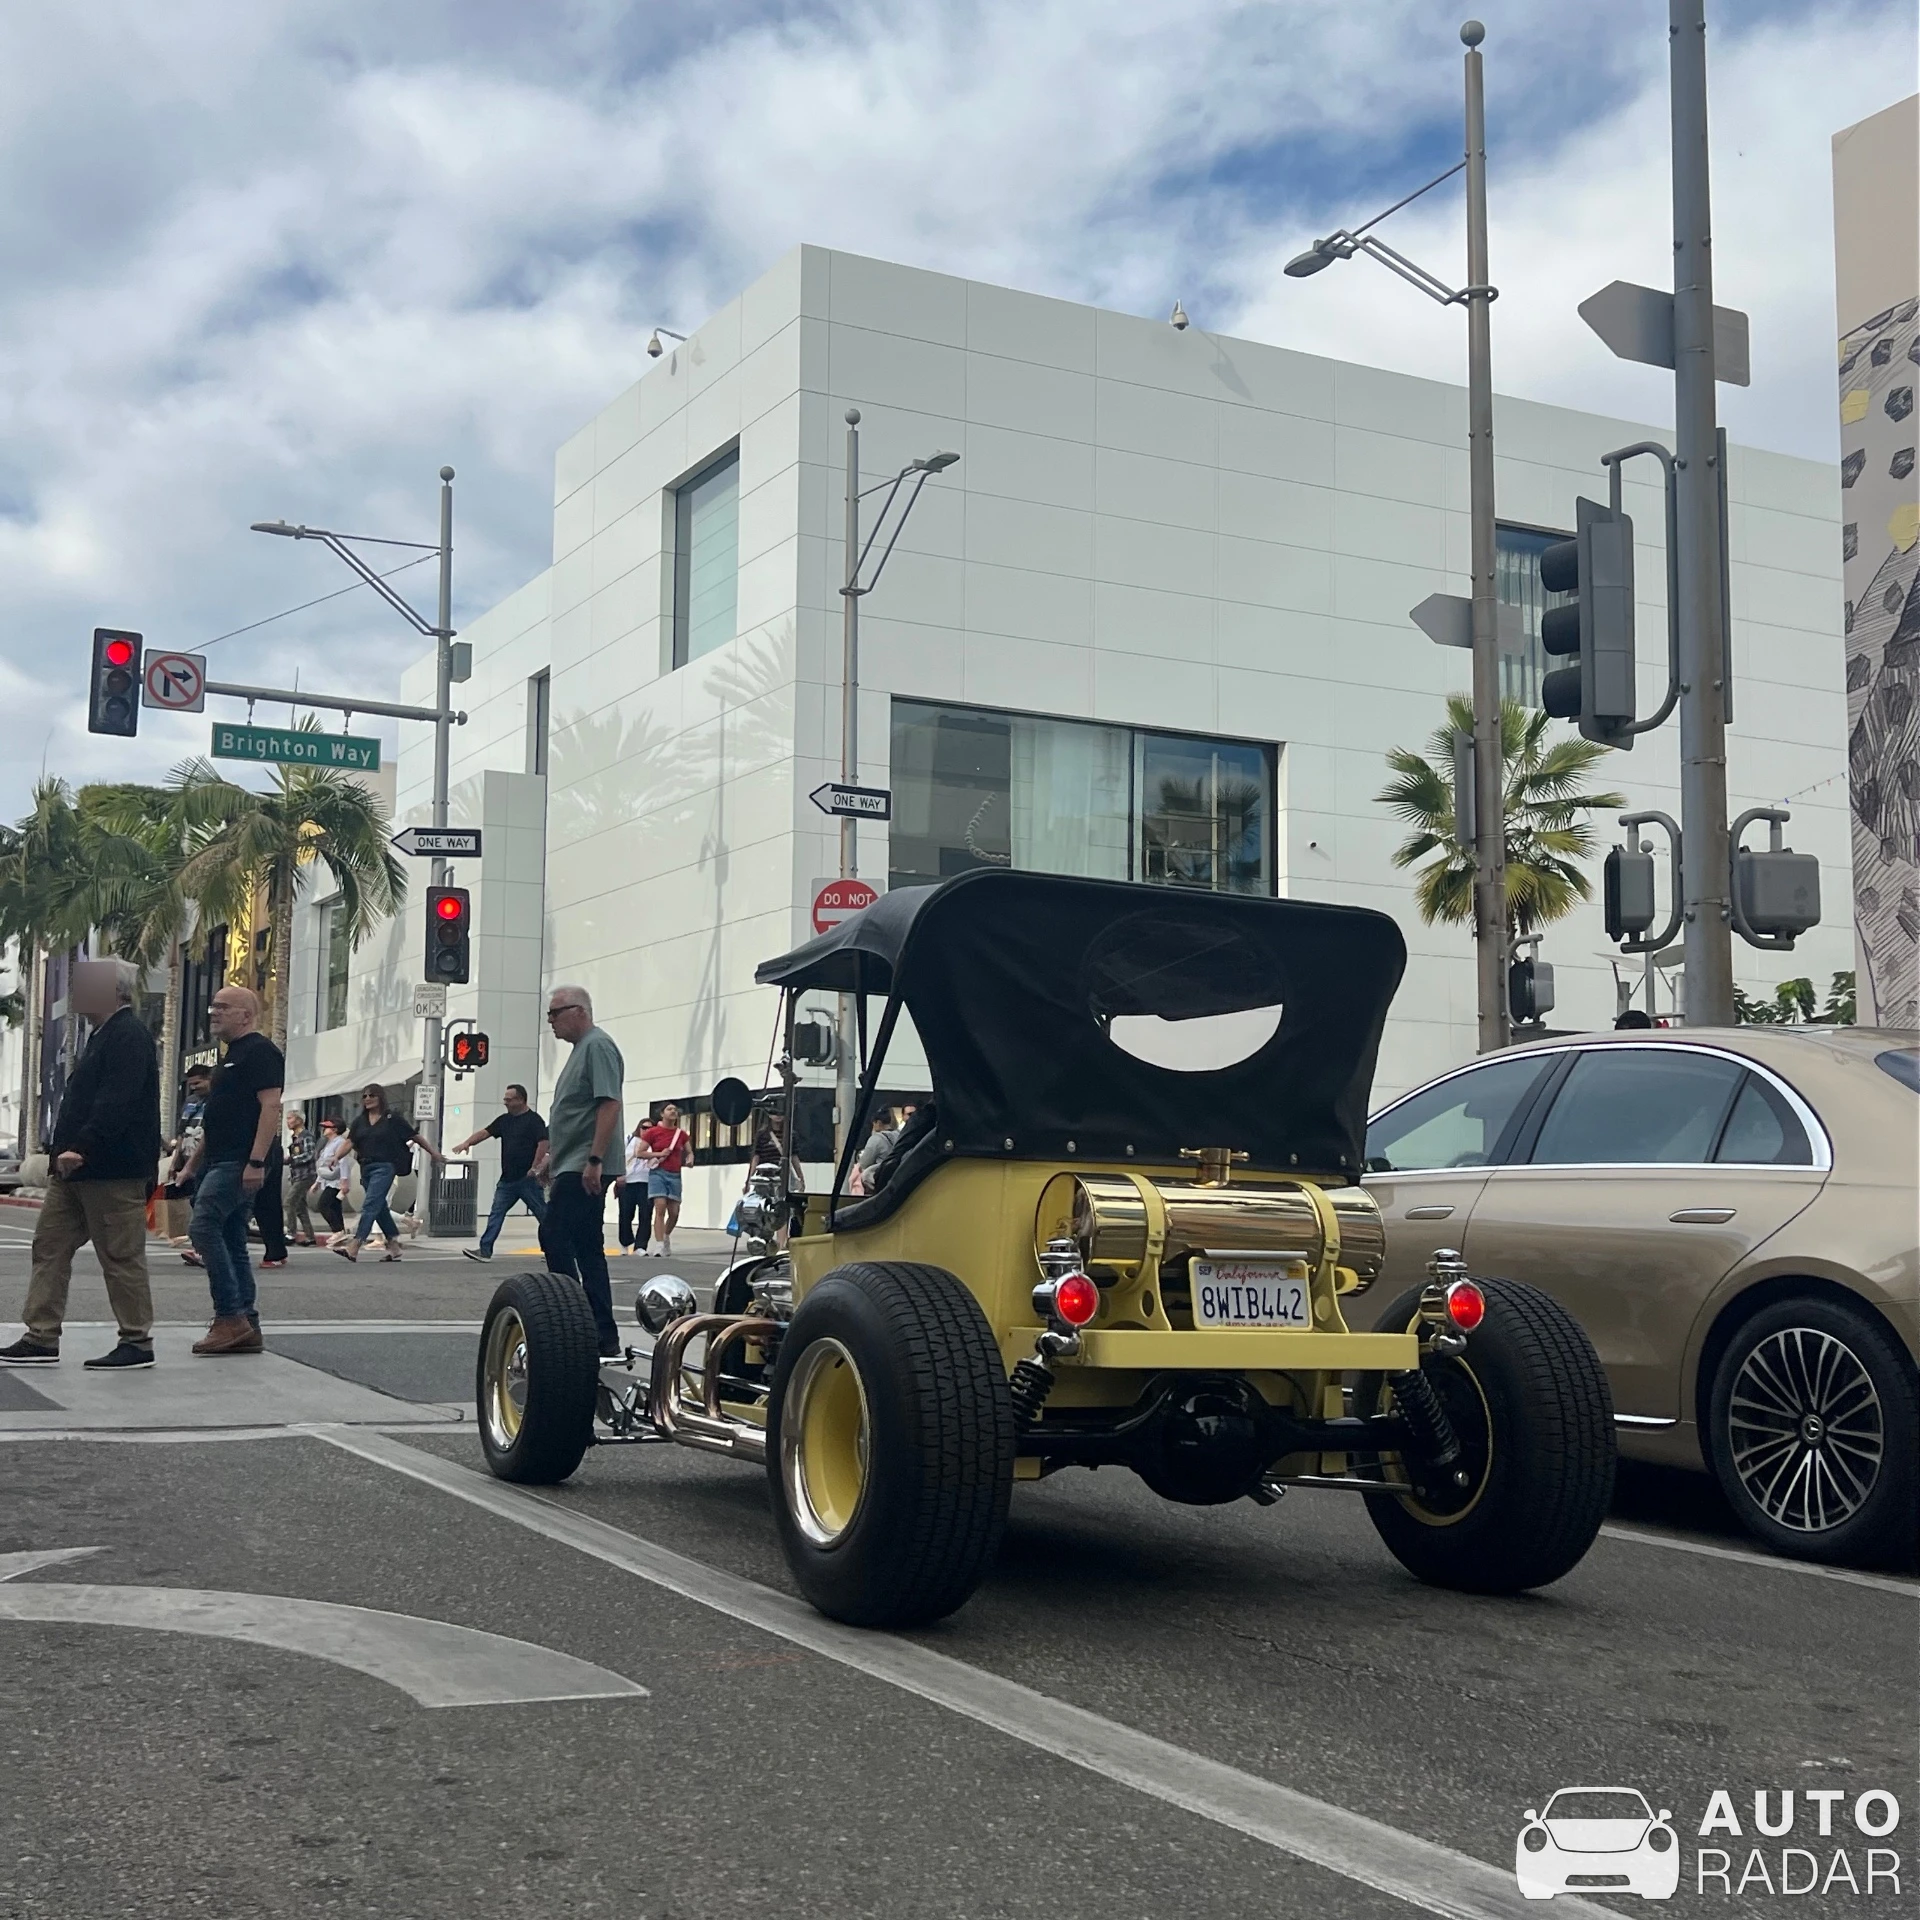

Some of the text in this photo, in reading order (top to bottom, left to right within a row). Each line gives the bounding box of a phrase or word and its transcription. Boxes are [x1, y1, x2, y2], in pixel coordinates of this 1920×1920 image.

[221, 732, 372, 767] Brighton Way
[834, 793, 881, 810] ONE WAY
[418, 836, 470, 848] ONE WAY
[824, 893, 873, 906] DO NOT
[416, 1003, 428, 1015] OK
[1216, 1265, 1288, 1285] California
[1202, 1286, 1304, 1320] 8WIB442
